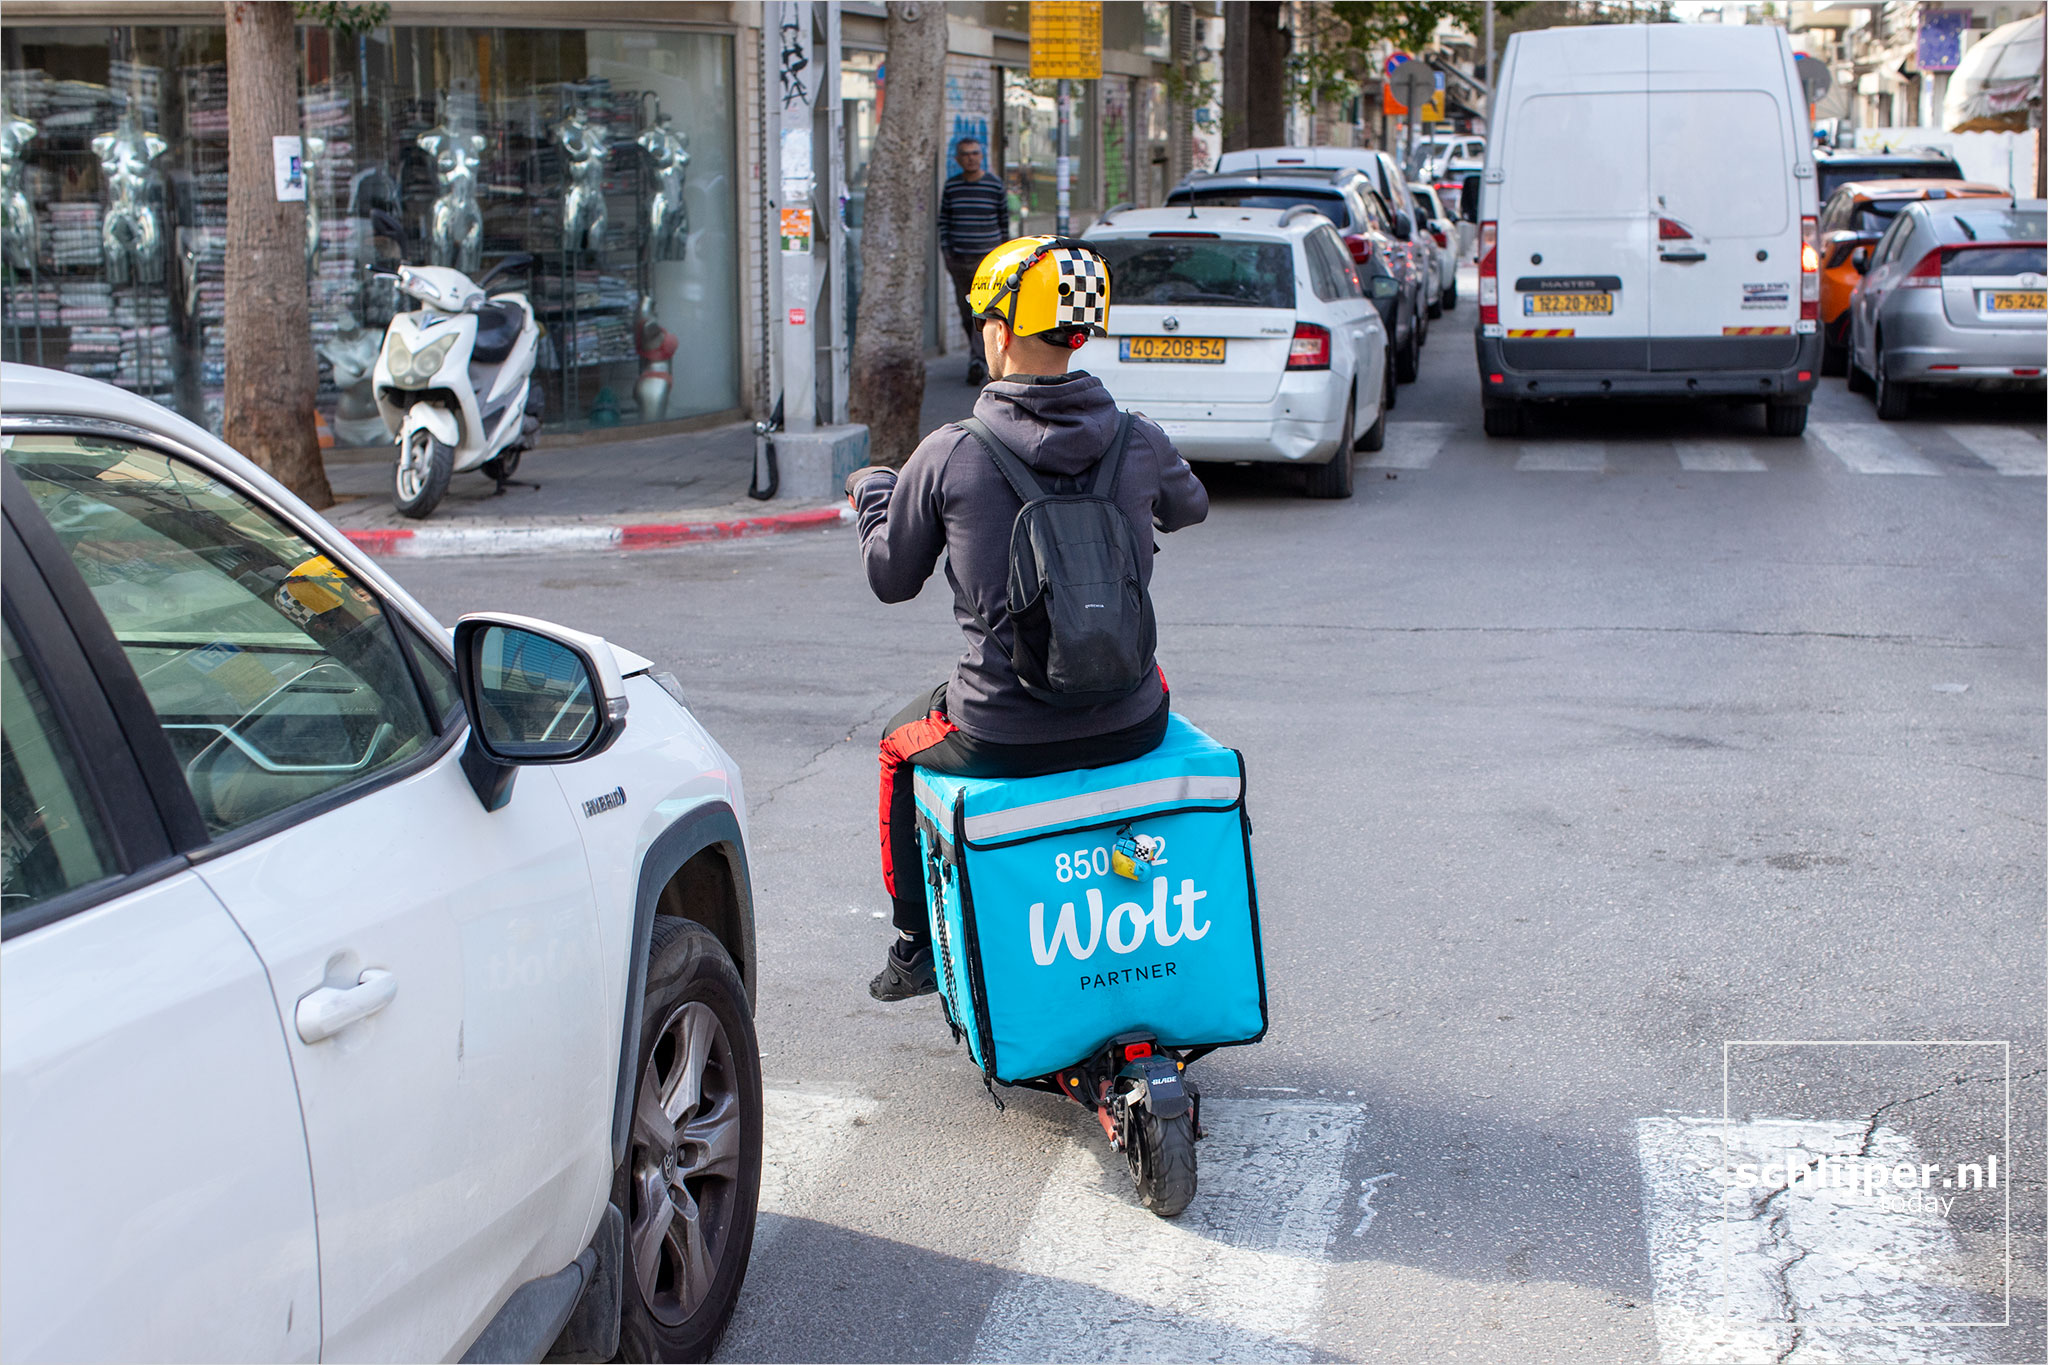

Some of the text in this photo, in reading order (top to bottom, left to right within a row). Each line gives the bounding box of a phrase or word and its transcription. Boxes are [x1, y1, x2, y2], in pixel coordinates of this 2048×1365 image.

[1540, 280, 1596, 288] MASTER
[583, 789, 624, 818] HYBRID
[1054, 836, 1168, 883] 8502
[1028, 876, 1212, 967] Wolt
[1079, 962, 1178, 990] PARTNER
[1152, 1076, 1177, 1086] BLADE
